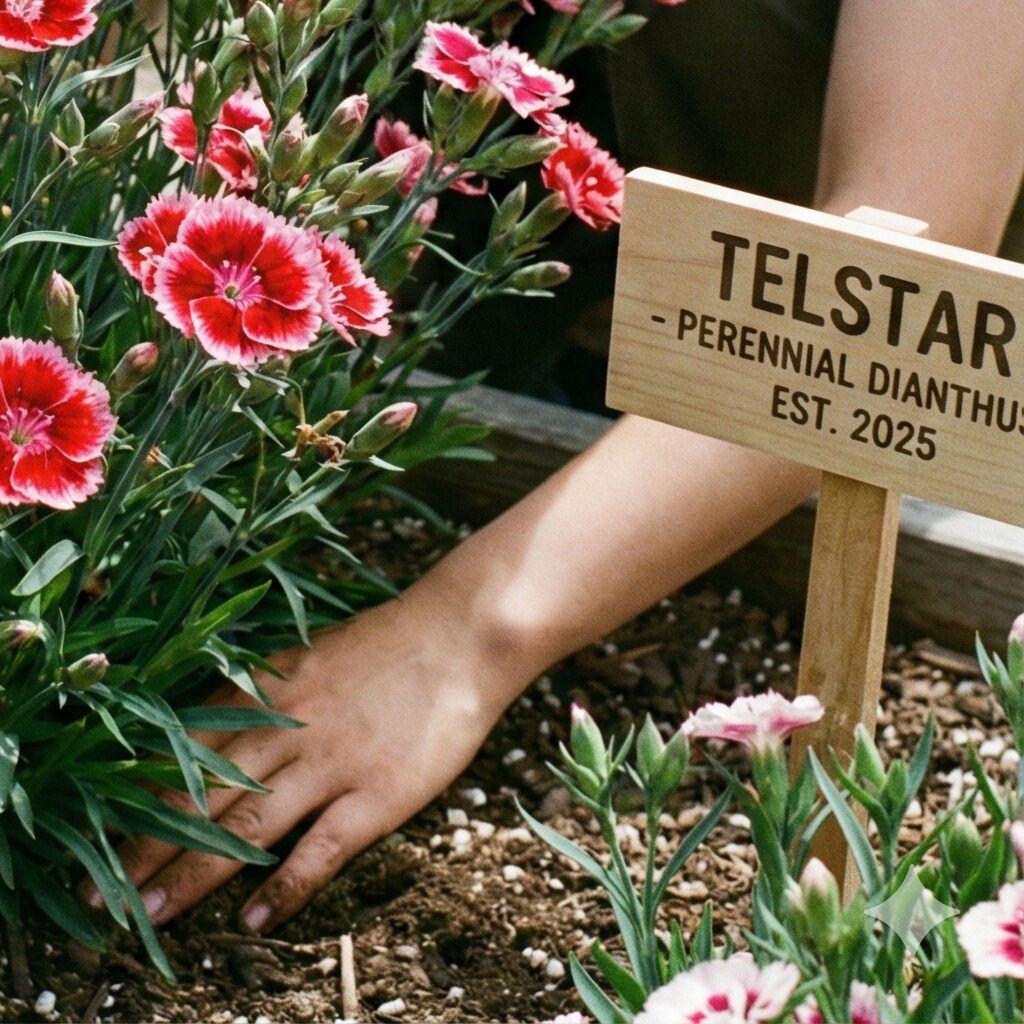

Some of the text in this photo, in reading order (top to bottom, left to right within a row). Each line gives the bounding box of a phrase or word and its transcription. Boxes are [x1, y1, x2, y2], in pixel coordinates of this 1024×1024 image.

[710, 229, 1017, 379] TELSTAR
[676, 307, 856, 390] PERENNIAL
[867, 360, 1024, 436] DIANTHU
[770, 383, 938, 462] EST. 2025
